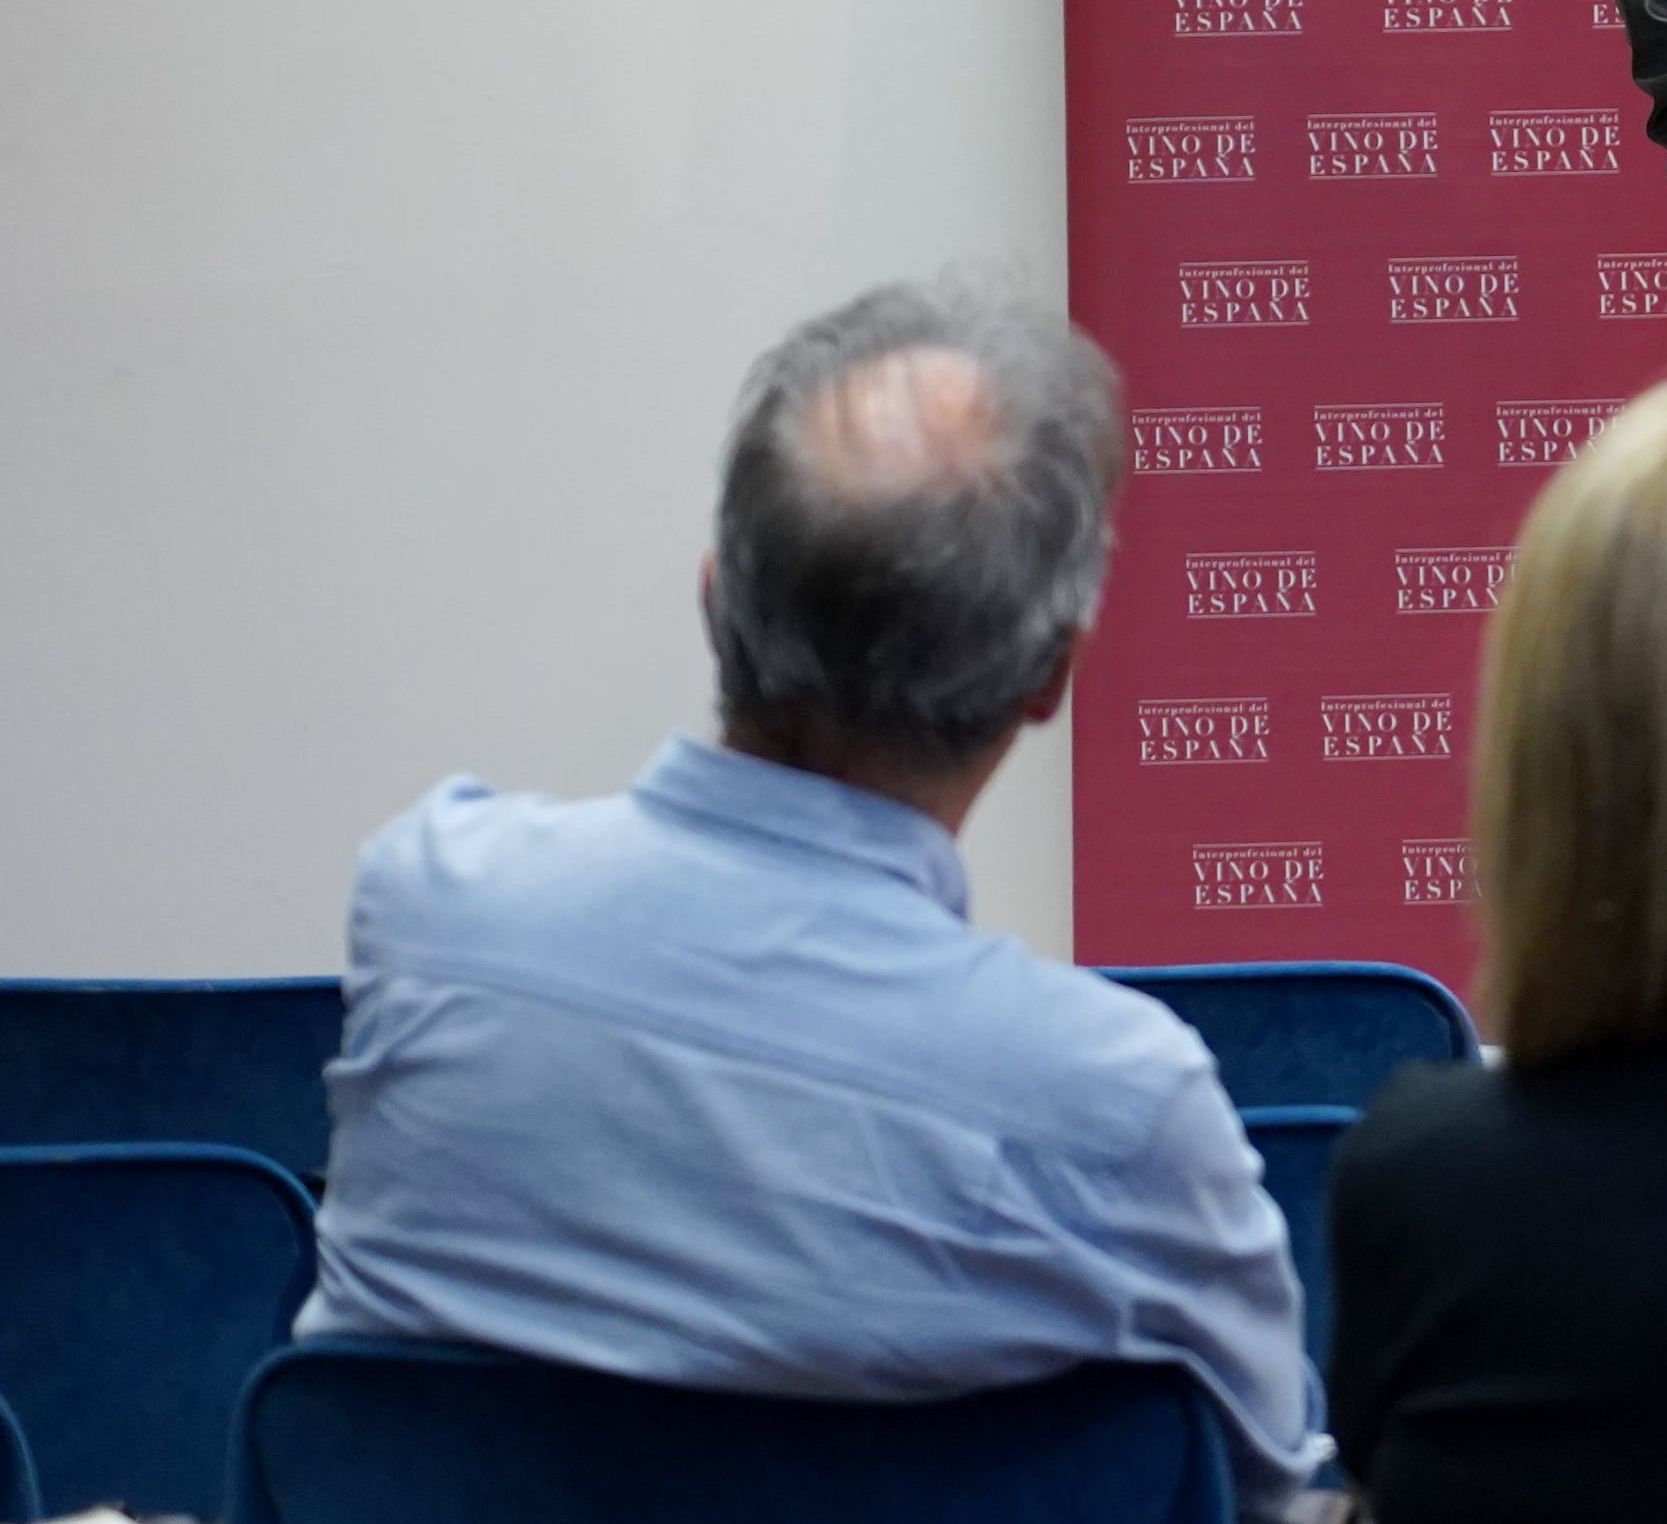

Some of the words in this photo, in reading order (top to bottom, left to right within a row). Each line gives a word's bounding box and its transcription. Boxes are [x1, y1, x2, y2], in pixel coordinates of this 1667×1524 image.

[1175, 8, 1303, 32] ESPAÑA
[1384, 4, 1513, 28] ESPAÑA
[1127, 133, 1201, 156] VINO
[1216, 134, 1256, 154] DE
[1308, 130, 1383, 152] VINO
[1398, 130, 1439, 151] DE
[1490, 126, 1565, 148] VINO
[1581, 126, 1620, 147] DE
[1129, 154, 1256, 179] ESPAÑA
[1310, 151, 1438, 175] ESPAÑA
[1492, 147, 1620, 171] ESPAÑA
[1180, 278, 1255, 300] VINO
[1270, 278, 1310, 298] DE
[1389, 273, 1464, 295] VINO
[1479, 274, 1519, 294] DE
[1182, 299, 1310, 323] ESPAÑA
[1391, 294, 1519, 319] ESPAÑA
[1133, 424, 1208, 446] VINO
[1223, 425, 1263, 445] DE
[1315, 420, 1390, 442] VINO
[1405, 421, 1445, 441] DE
[1497, 416, 1573, 438] VINO
[1135, 445, 1263, 470] ESPAÑA
[1317, 441, 1445, 466] ESPAÑA
[1187, 568, 1262, 591] VINO
[1277, 569, 1317, 589] DE
[1396, 564, 1471, 586] VINO
[1189, 590, 1317, 614] ESPAÑA
[1139, 715, 1214, 737] VINO
[1230, 715, 1270, 736] DE
[1322, 711, 1397, 733] VINO
[1412, 711, 1452, 732] DE
[1141, 736, 1270, 760] ESPAÑA
[1324, 732, 1452, 756] ESPAÑA
[1194, 859, 1269, 882] VINO
[1284, 860, 1324, 880] DE
[1196, 880, 1324, 905] ESPAÑA
